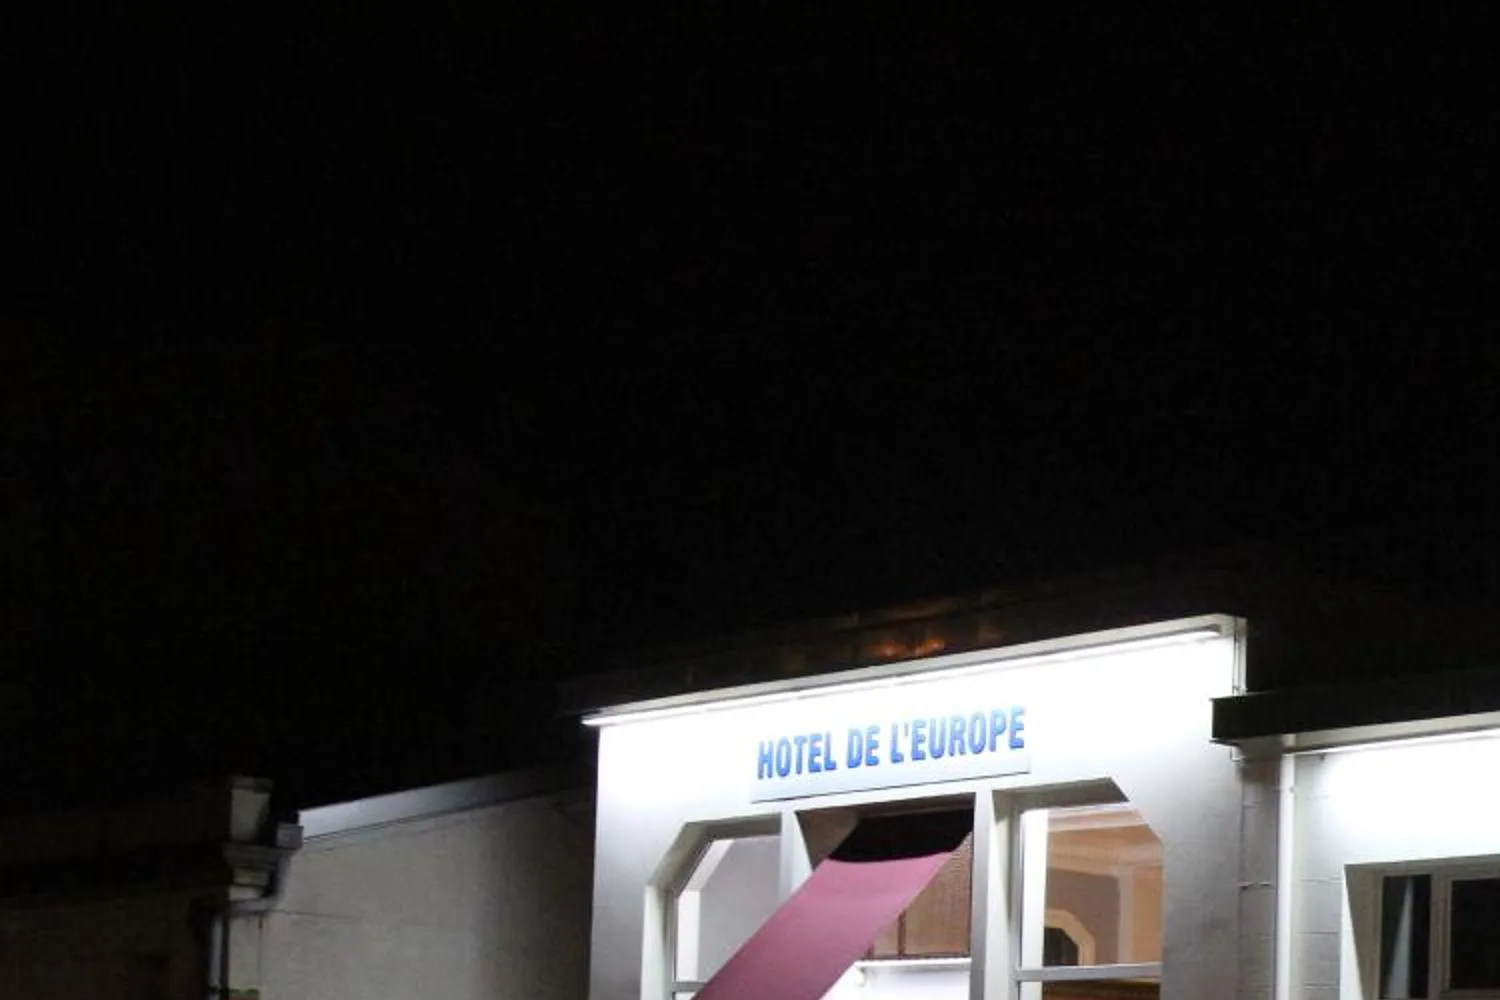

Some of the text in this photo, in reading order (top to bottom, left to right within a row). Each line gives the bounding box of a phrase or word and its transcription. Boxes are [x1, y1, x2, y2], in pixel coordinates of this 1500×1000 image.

[756, 704, 1026, 780] HOTEL DE L'EUROPE
